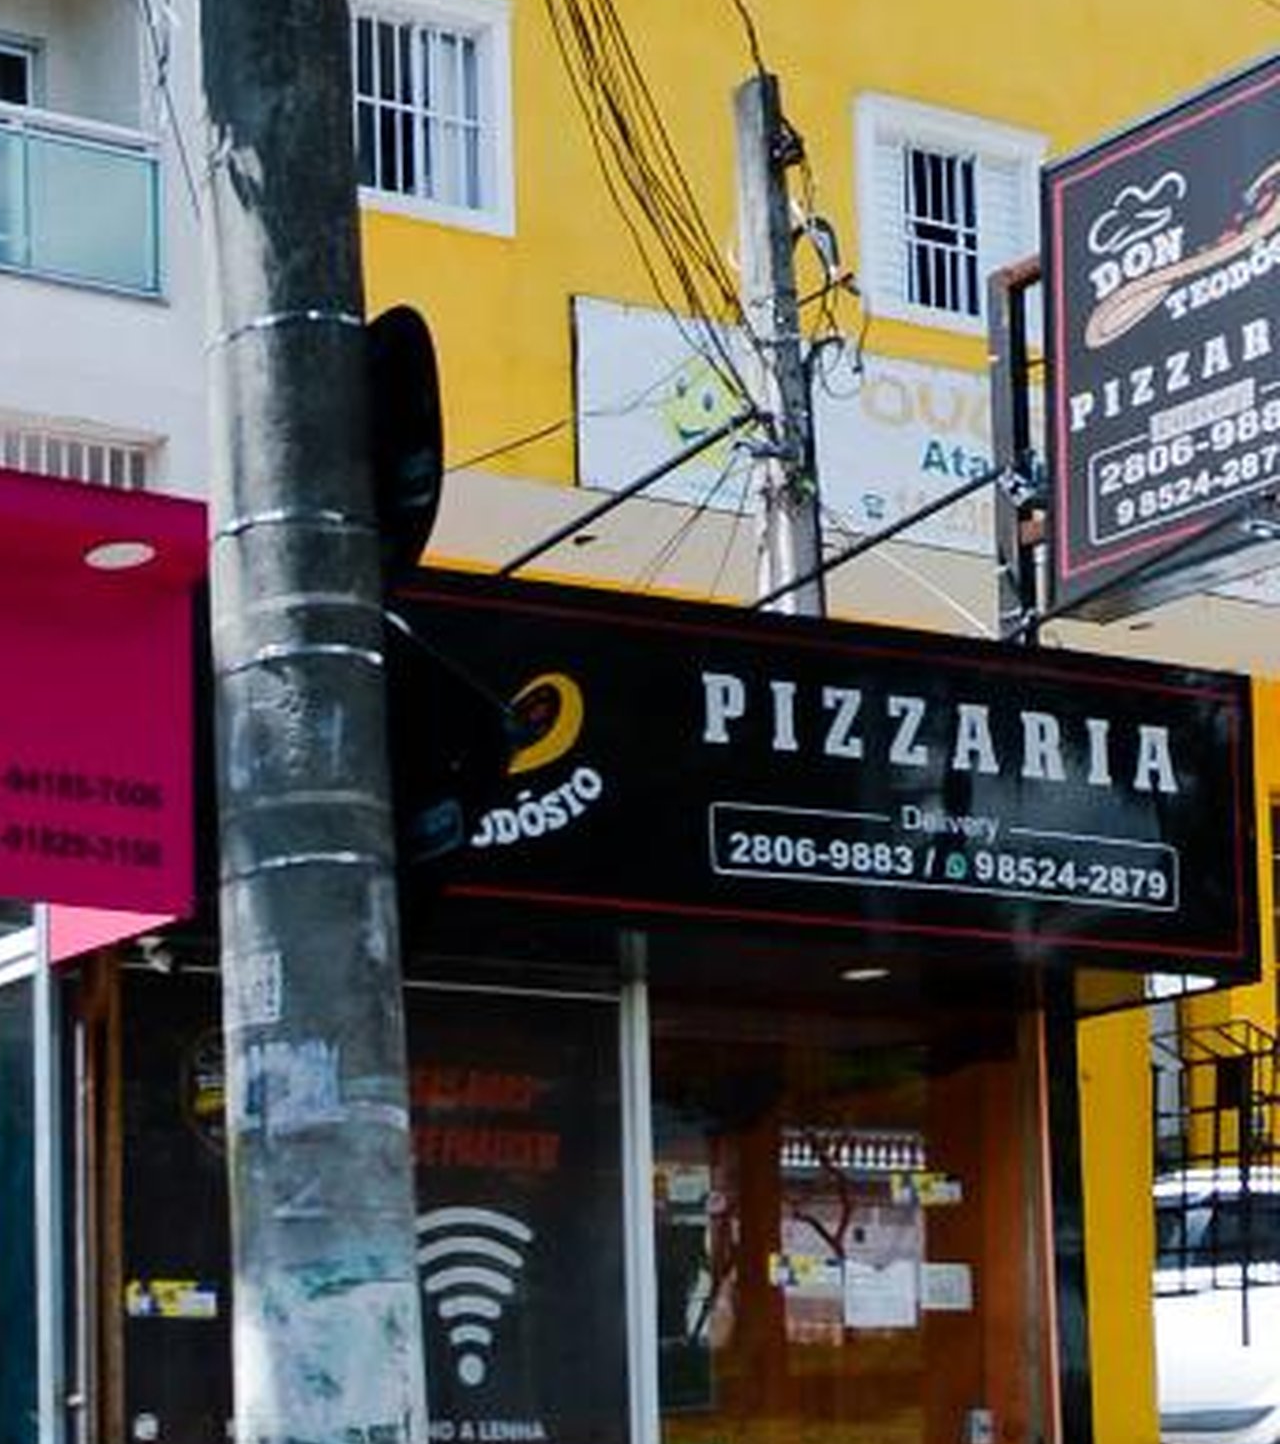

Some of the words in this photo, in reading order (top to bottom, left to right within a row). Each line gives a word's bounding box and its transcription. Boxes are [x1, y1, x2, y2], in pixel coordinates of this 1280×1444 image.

[1089, 227, 1184, 300] DON
[702, 671, 1180, 793] PIZZARIA
[902, 805, 1000, 843] Delivery
[729, 831, 914, 876] 2806-9883
[974, 852, 1169, 900] 98524-2879
